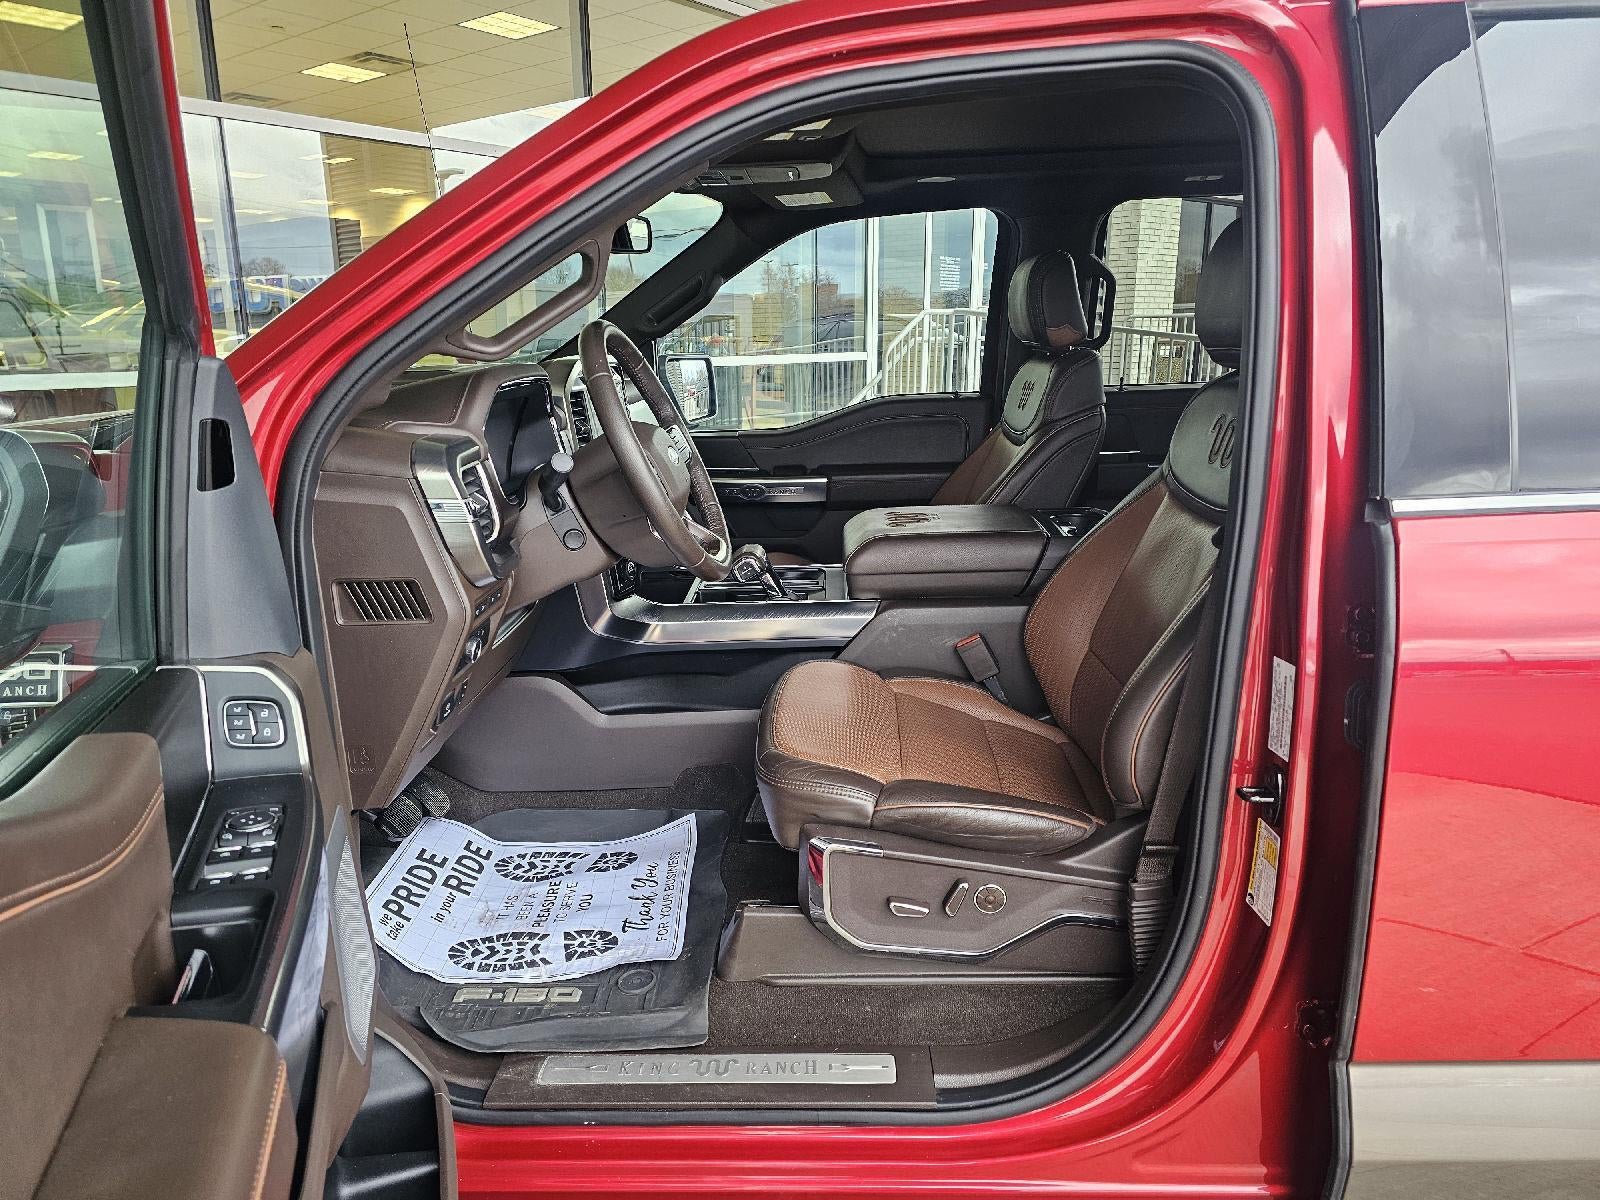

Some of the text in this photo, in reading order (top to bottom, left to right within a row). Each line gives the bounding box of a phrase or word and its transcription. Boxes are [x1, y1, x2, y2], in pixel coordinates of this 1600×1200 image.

[2, 684, 48, 697] ANCH
[382, 848, 449, 923] PRIDE
[431, 840, 494, 923] in your RIDE
[501, 895, 519, 911] HAS
[532, 880, 563, 928] PLEASURE
[553, 882, 579, 924] TO SERVE
[576, 894, 593, 912] YOU
[621, 862, 659, 933] Thank You
[656, 851, 681, 942] FOR YOUR BUSINESS
[379, 913, 393, 926] we
[515, 901, 536, 921] BEEN
[386, 920, 405, 940] take
[452, 987, 583, 1003] F-150
[617, 1059, 820, 1077] KING RANCH
